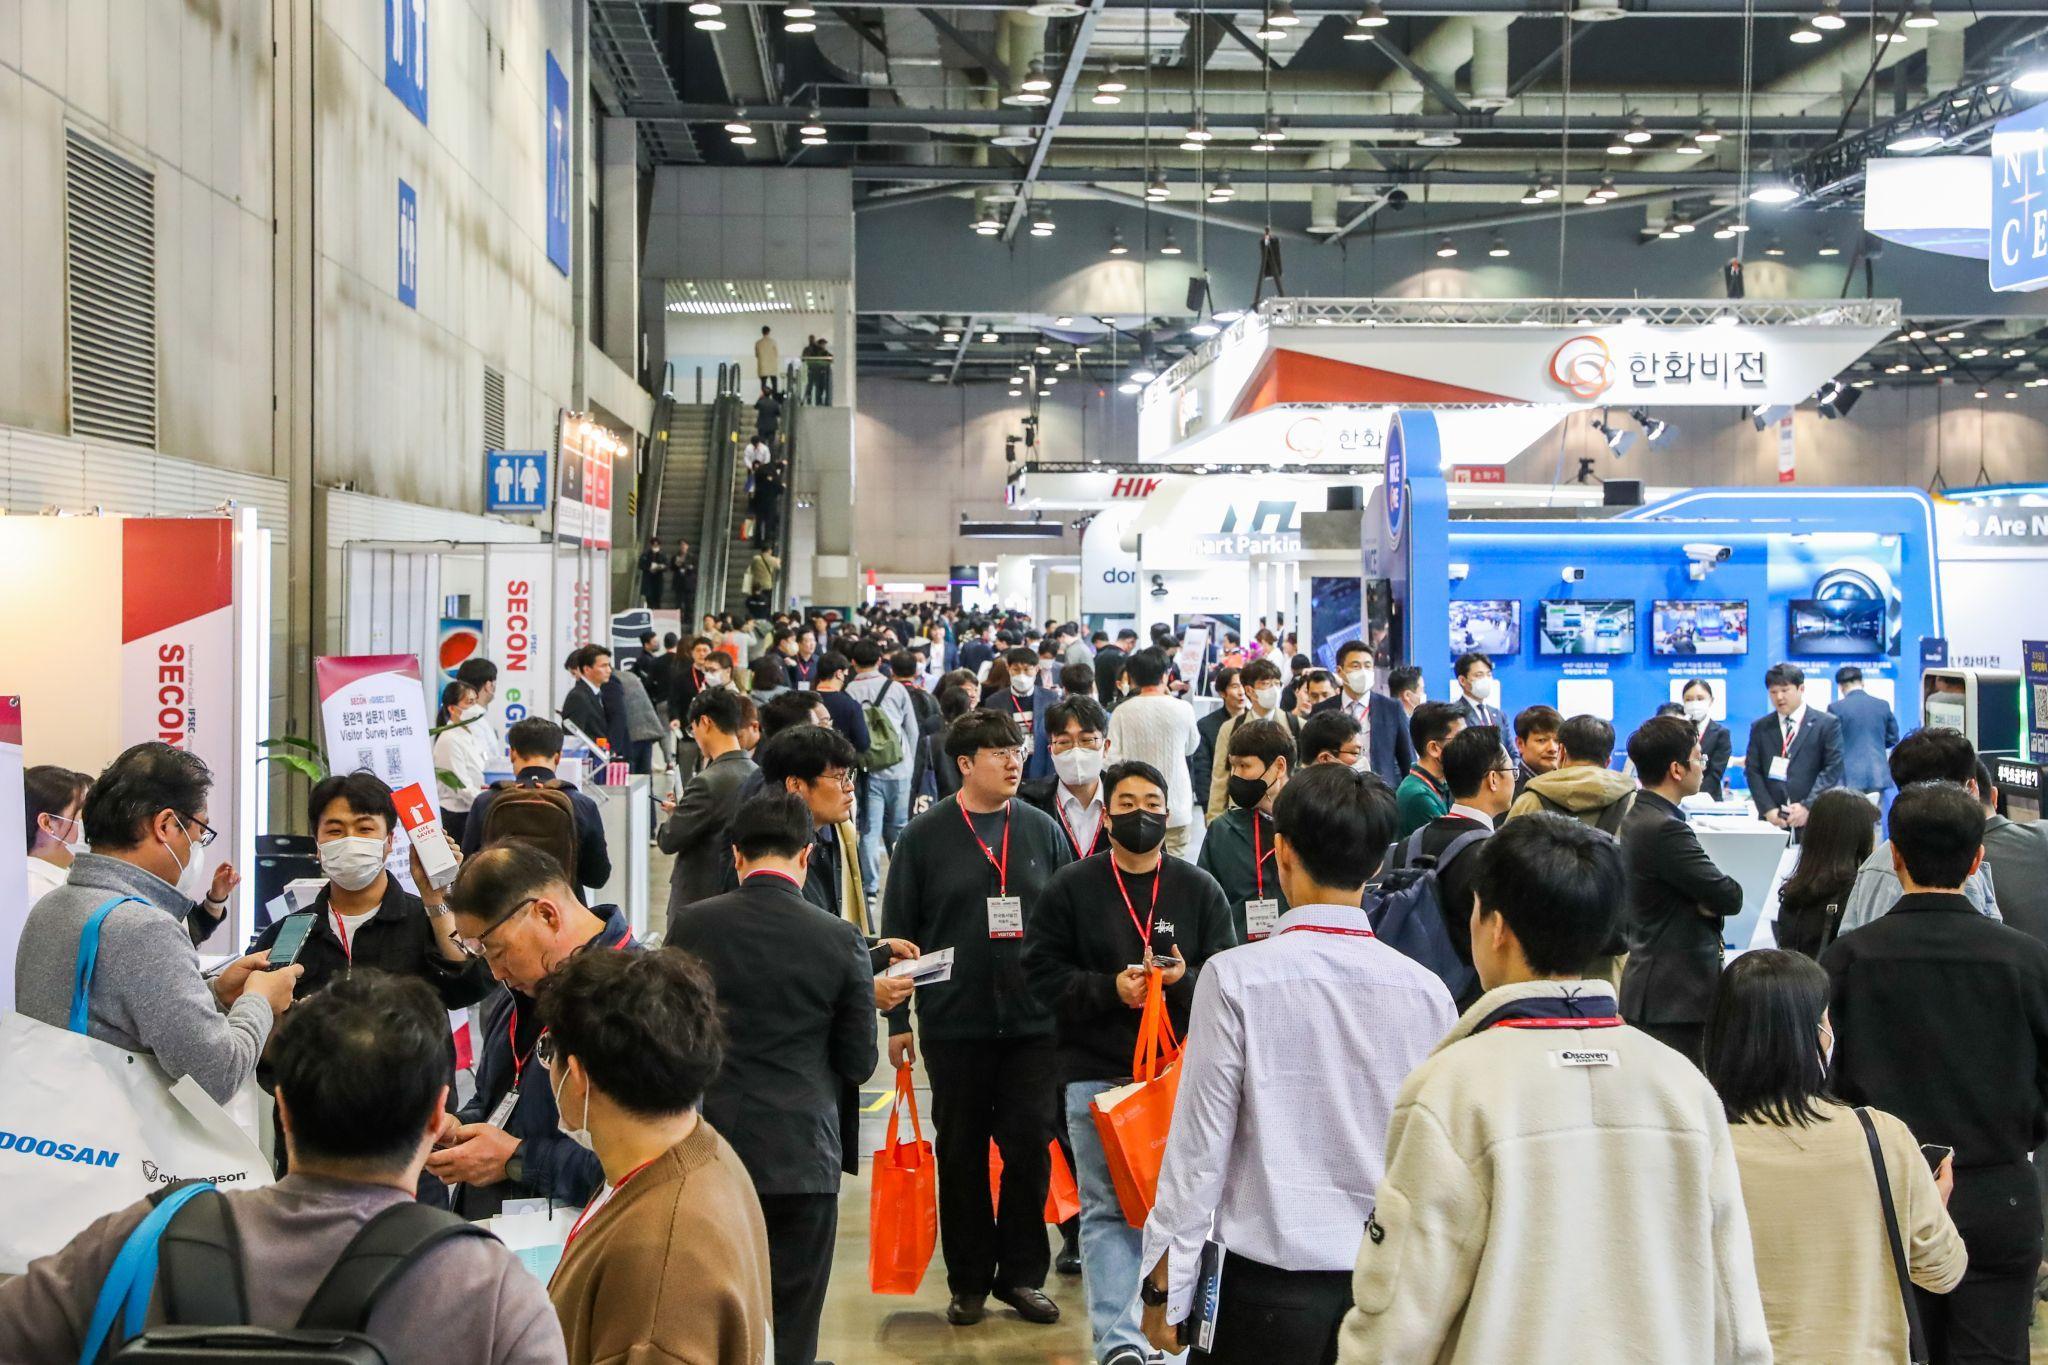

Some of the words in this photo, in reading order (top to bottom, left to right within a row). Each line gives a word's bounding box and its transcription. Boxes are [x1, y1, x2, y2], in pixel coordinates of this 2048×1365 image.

[1629, 351, 1766, 386] 한화비전
[1984, 515, 2027, 536] Are
[507, 580, 528, 672] SECON
[158, 644, 185, 751] SECON
[188, 708, 196, 734] IFSEC
[342, 711, 363, 726] 참관객
[366, 709, 386, 725] 설문지
[387, 708, 407, 722] 이벤트
[340, 728, 363, 741] Visitor
[365, 727, 388, 740] Survey
[390, 725, 413, 737] Events
[416, 828, 435, 839] SAVER
[0, 1131, 120, 1168] DOOSAN
